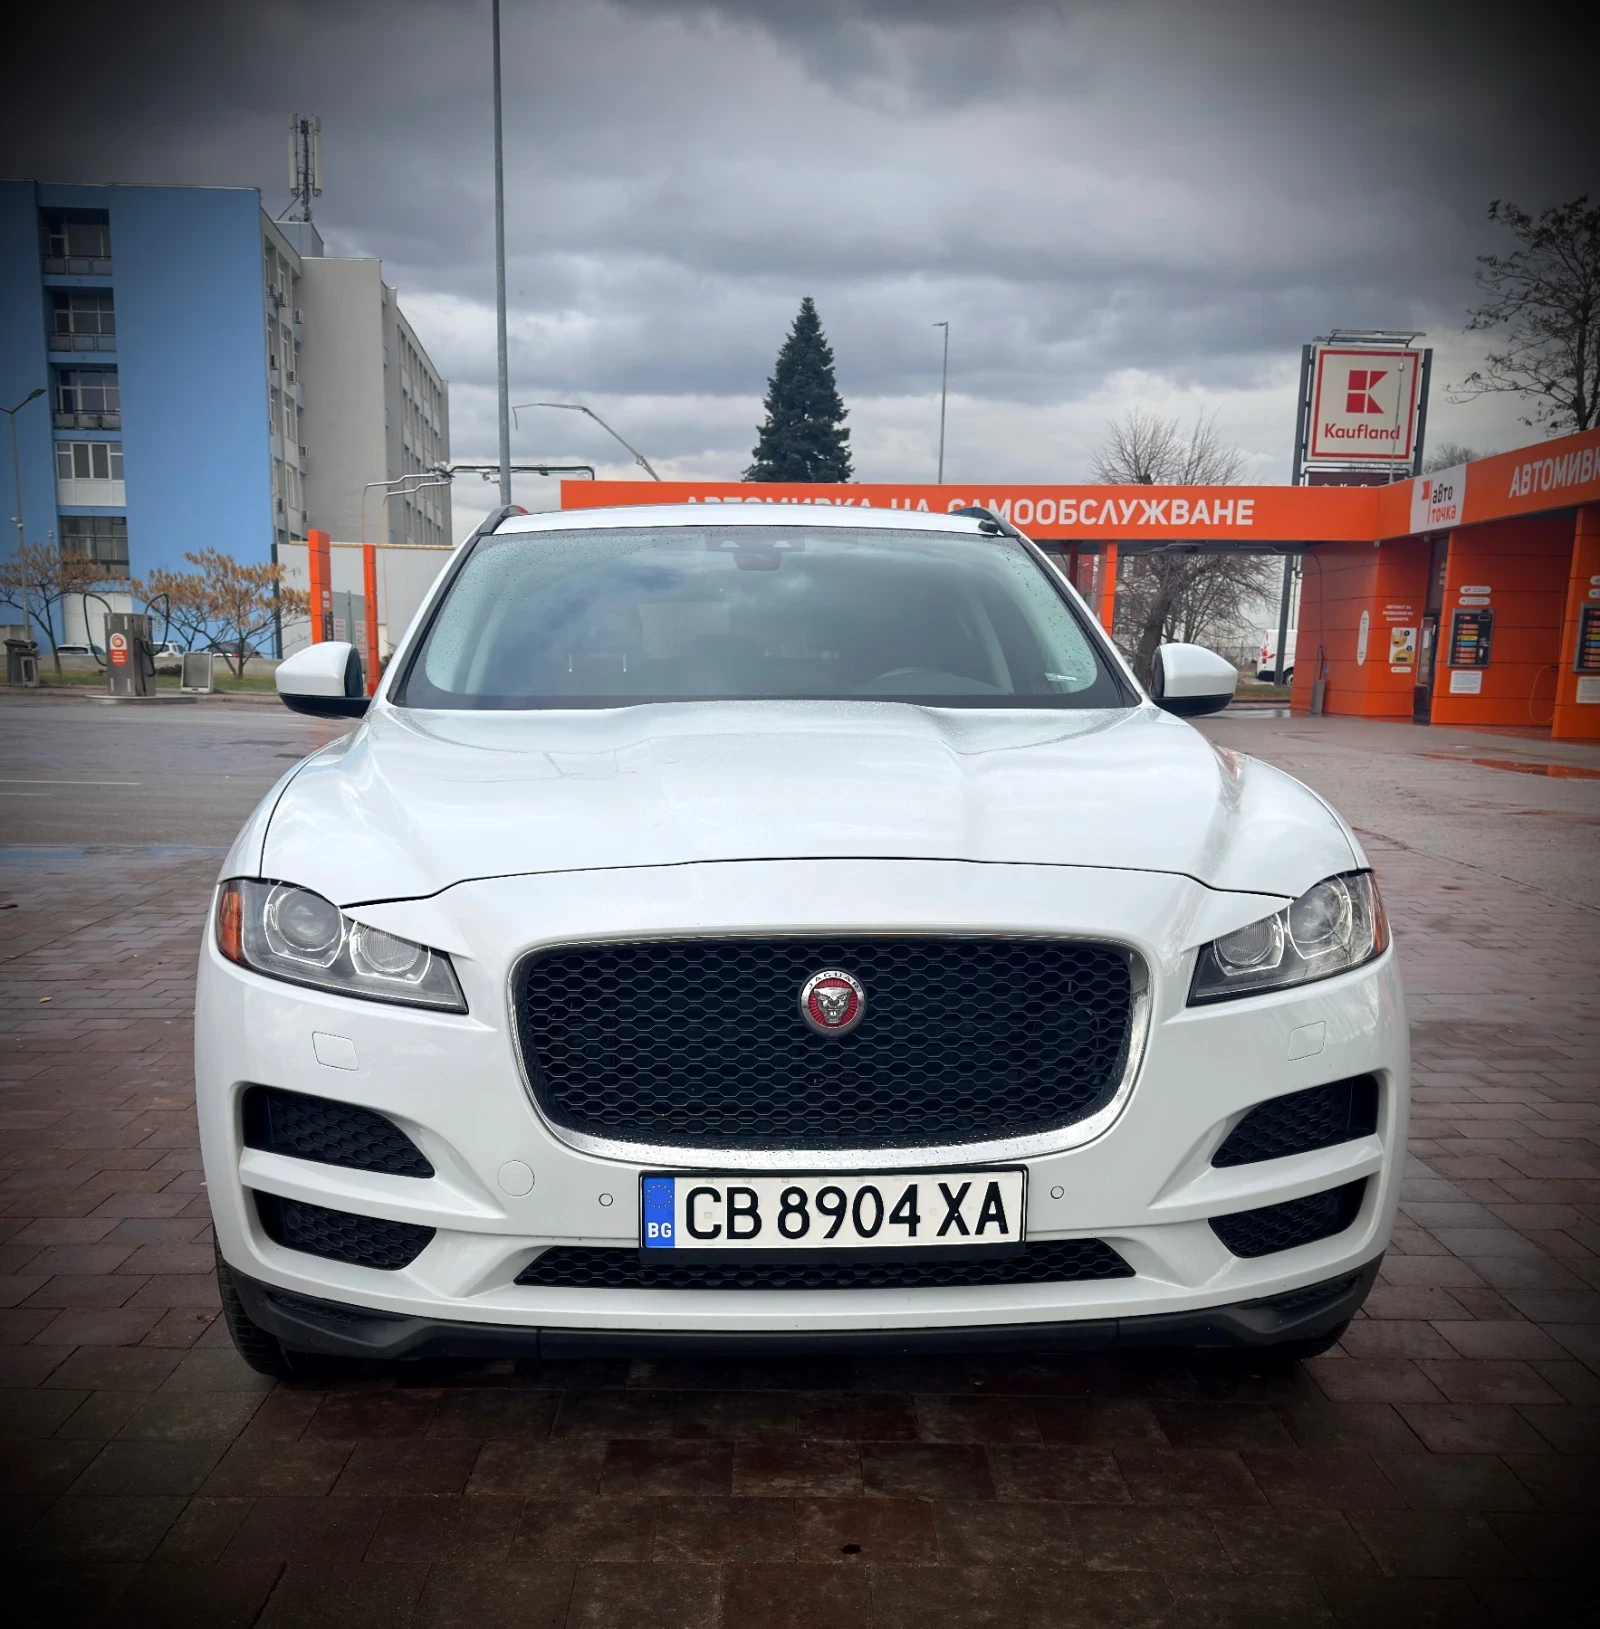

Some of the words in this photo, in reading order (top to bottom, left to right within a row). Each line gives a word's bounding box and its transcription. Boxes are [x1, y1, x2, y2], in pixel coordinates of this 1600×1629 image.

[1324, 423, 1401, 440] Kaufland
[1432, 504, 1457, 523] точка
[808, 972, 859, 990] JAGUAR
[685, 1186, 762, 1240] CB
[777, 1183, 921, 1240] 8904
[936, 1181, 1009, 1237] XA
[647, 1222, 672, 1238] BG
